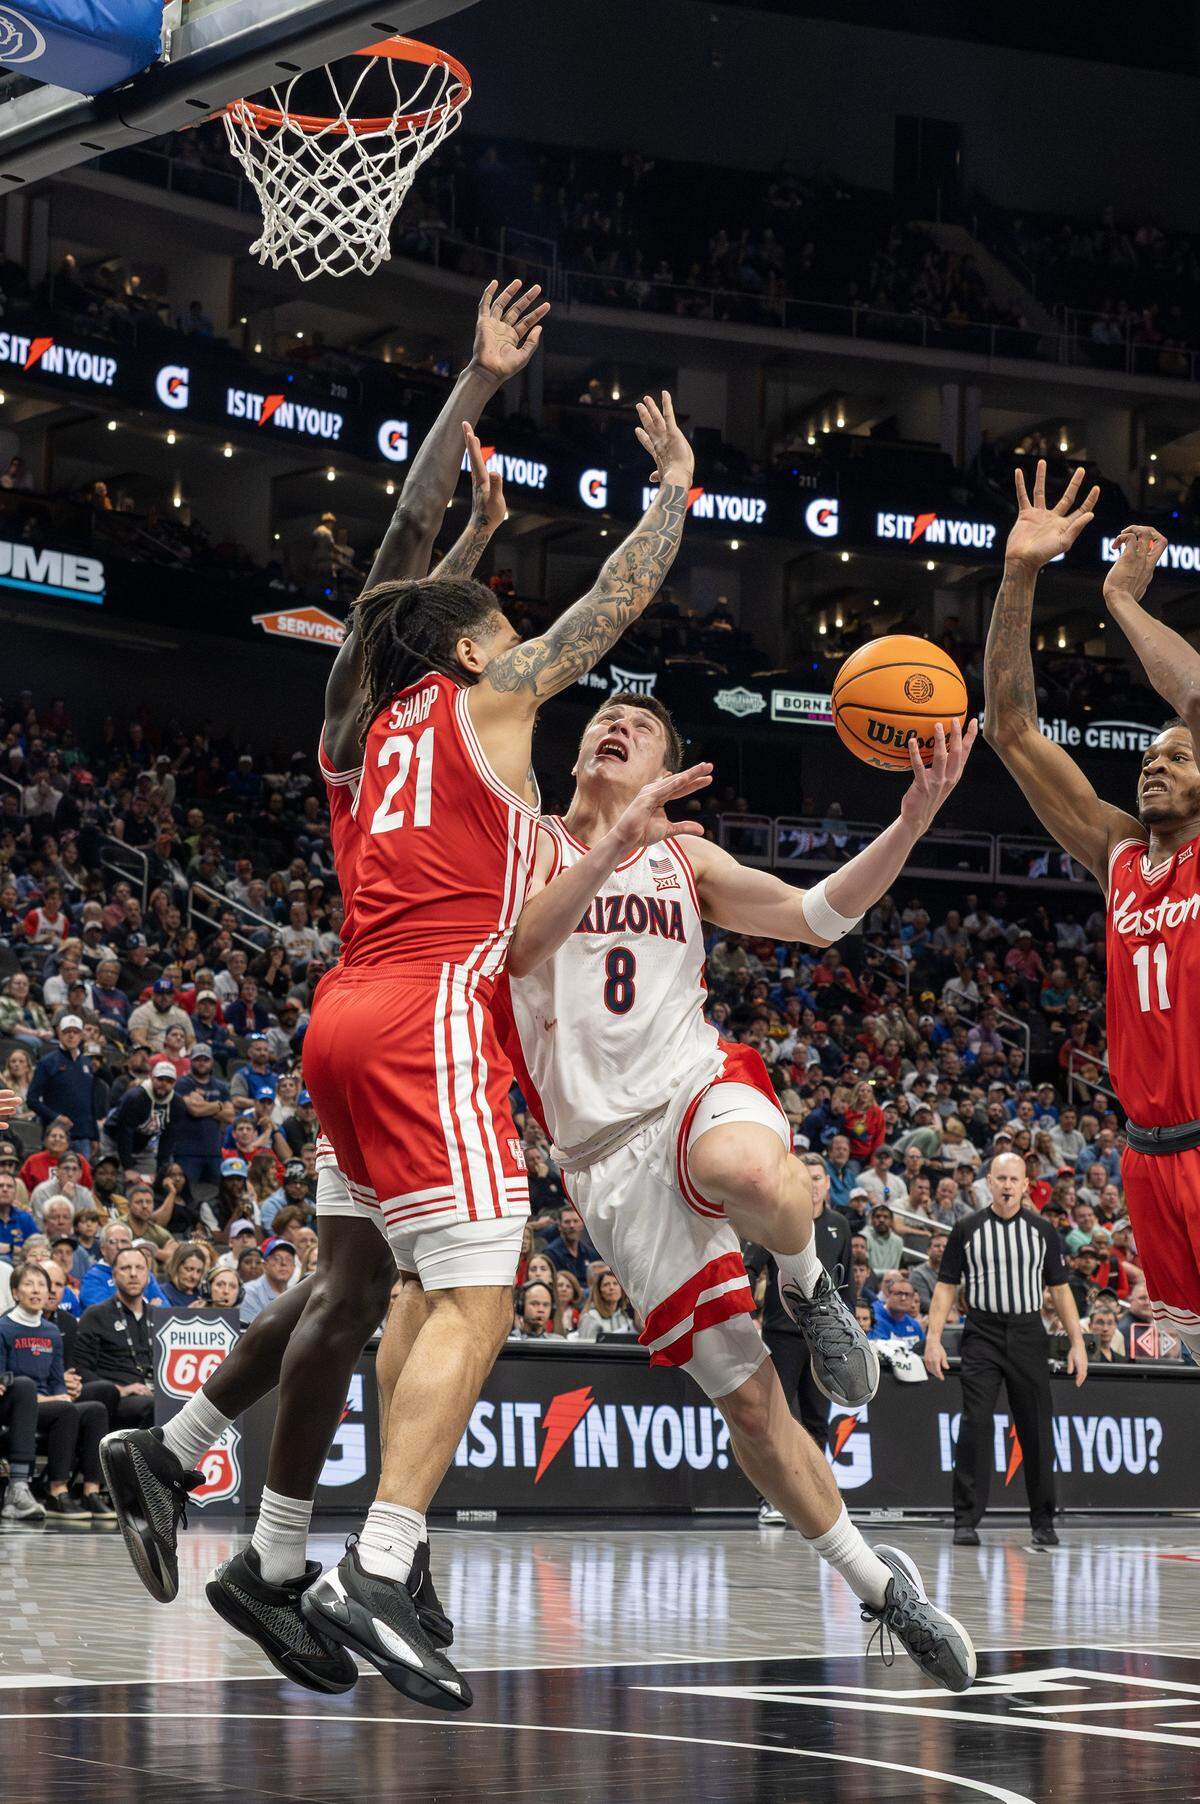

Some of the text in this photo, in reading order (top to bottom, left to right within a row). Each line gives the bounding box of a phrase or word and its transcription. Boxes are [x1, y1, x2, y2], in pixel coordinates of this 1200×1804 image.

[11, 335, 30, 365] IT
[41, 345, 64, 374] IN
[64, 348, 117, 386] YOU?
[156, 365, 189, 409] G
[227, 388, 343, 441] IS IT IN YOU?
[378, 420, 408, 461] G
[504, 456, 548, 489] YOU?
[579, 469, 608, 509] G
[692, 493, 714, 517] IN
[715, 495, 767, 524] YOU?
[806, 499, 838, 537] G
[877, 512, 996, 549] IS IT IN YOU?
[389, 685, 439, 730] SHARP
[783, 697, 820, 711] BORN
[1038, 718, 1081, 746] bile
[370, 727, 434, 834] 21
[573, 893, 687, 943] IZONA
[604, 946, 636, 1014] 8
[1133, 942, 1171, 1012] 11
[170, 1331, 226, 1346] PHILLIPS
[174, 1353, 222, 1385] 66
[501, 1402, 541, 1467] IT
[574, 1403, 618, 1468] IN
[622, 1405, 731, 1470] YOU?
[1072, 1416, 1163, 1475] YOU?
[201, 1454, 225, 1486] 6
